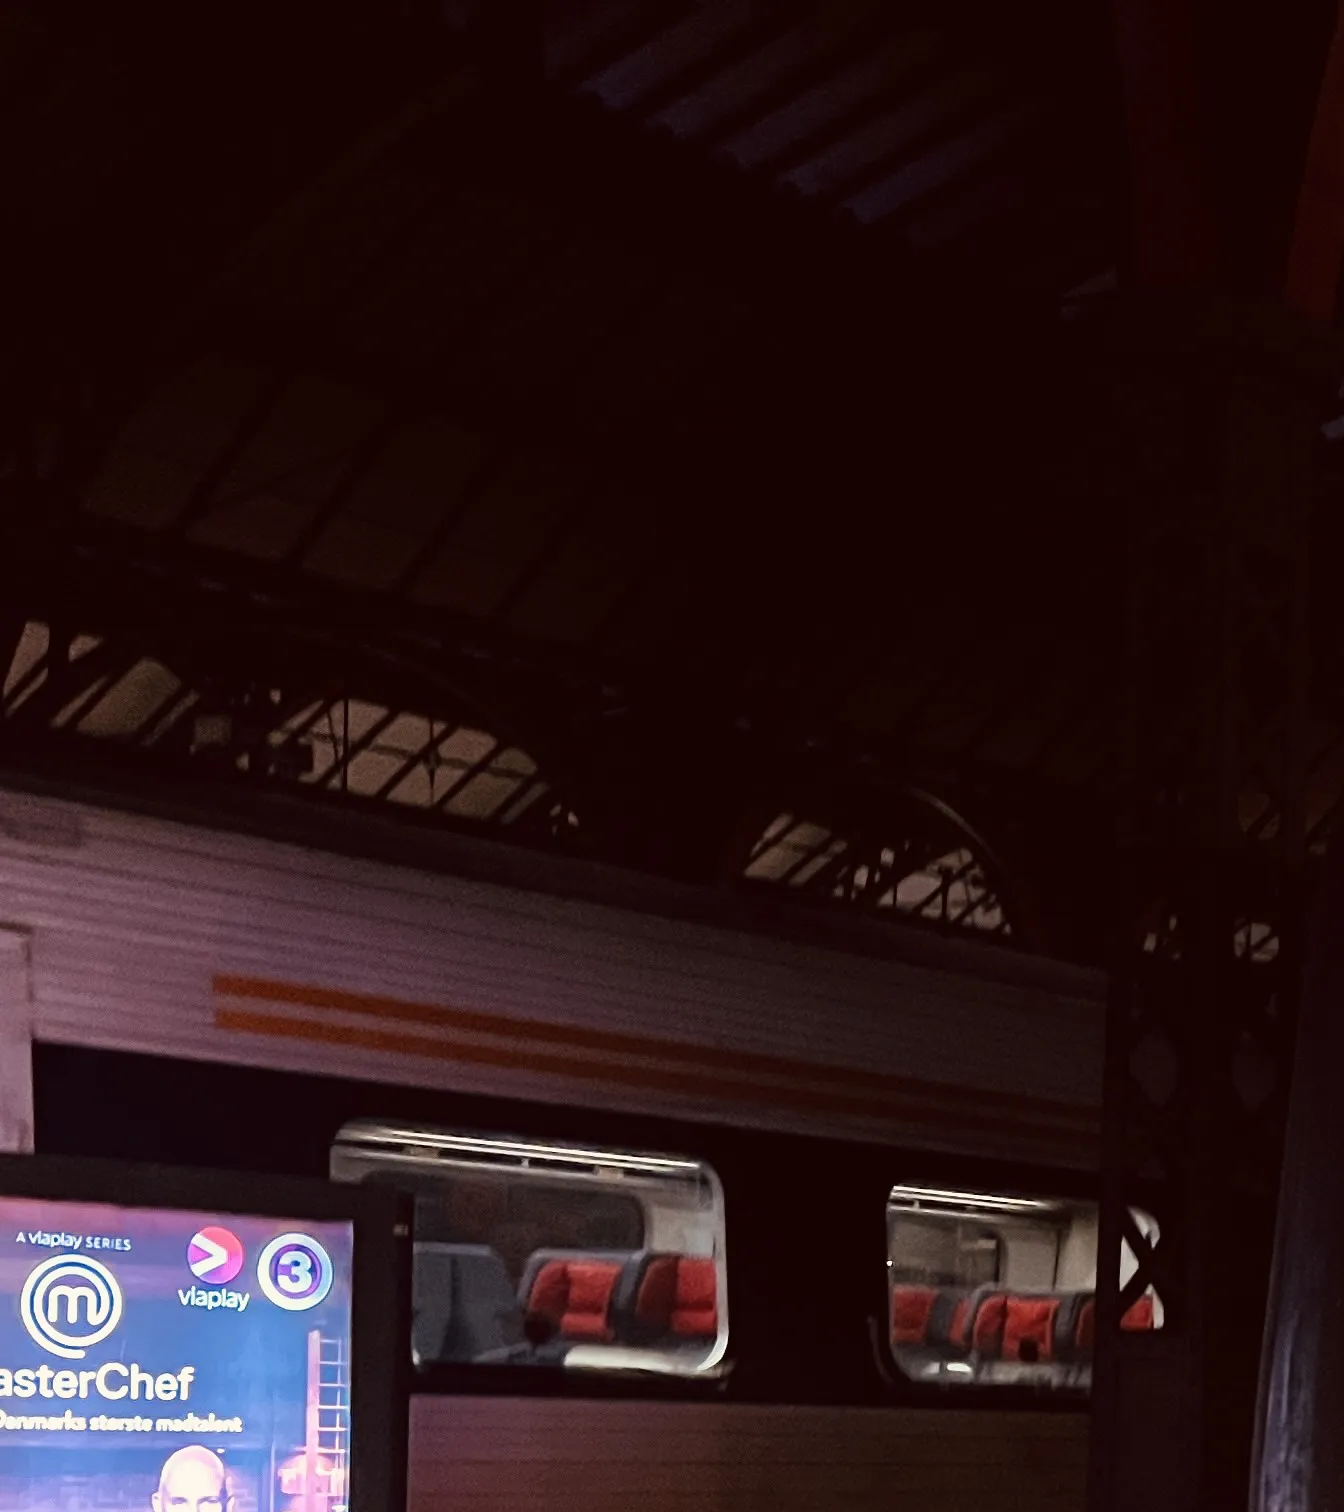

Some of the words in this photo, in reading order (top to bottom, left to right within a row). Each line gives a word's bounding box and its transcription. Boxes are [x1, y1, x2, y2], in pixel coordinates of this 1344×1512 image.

[16, 1231, 26, 1243] A
[28, 1230, 82, 1250] viaplay
[85, 1236, 132, 1251] SERIES
[277, 1250, 313, 1294] 3
[178, 1285, 251, 1313] viaplay
